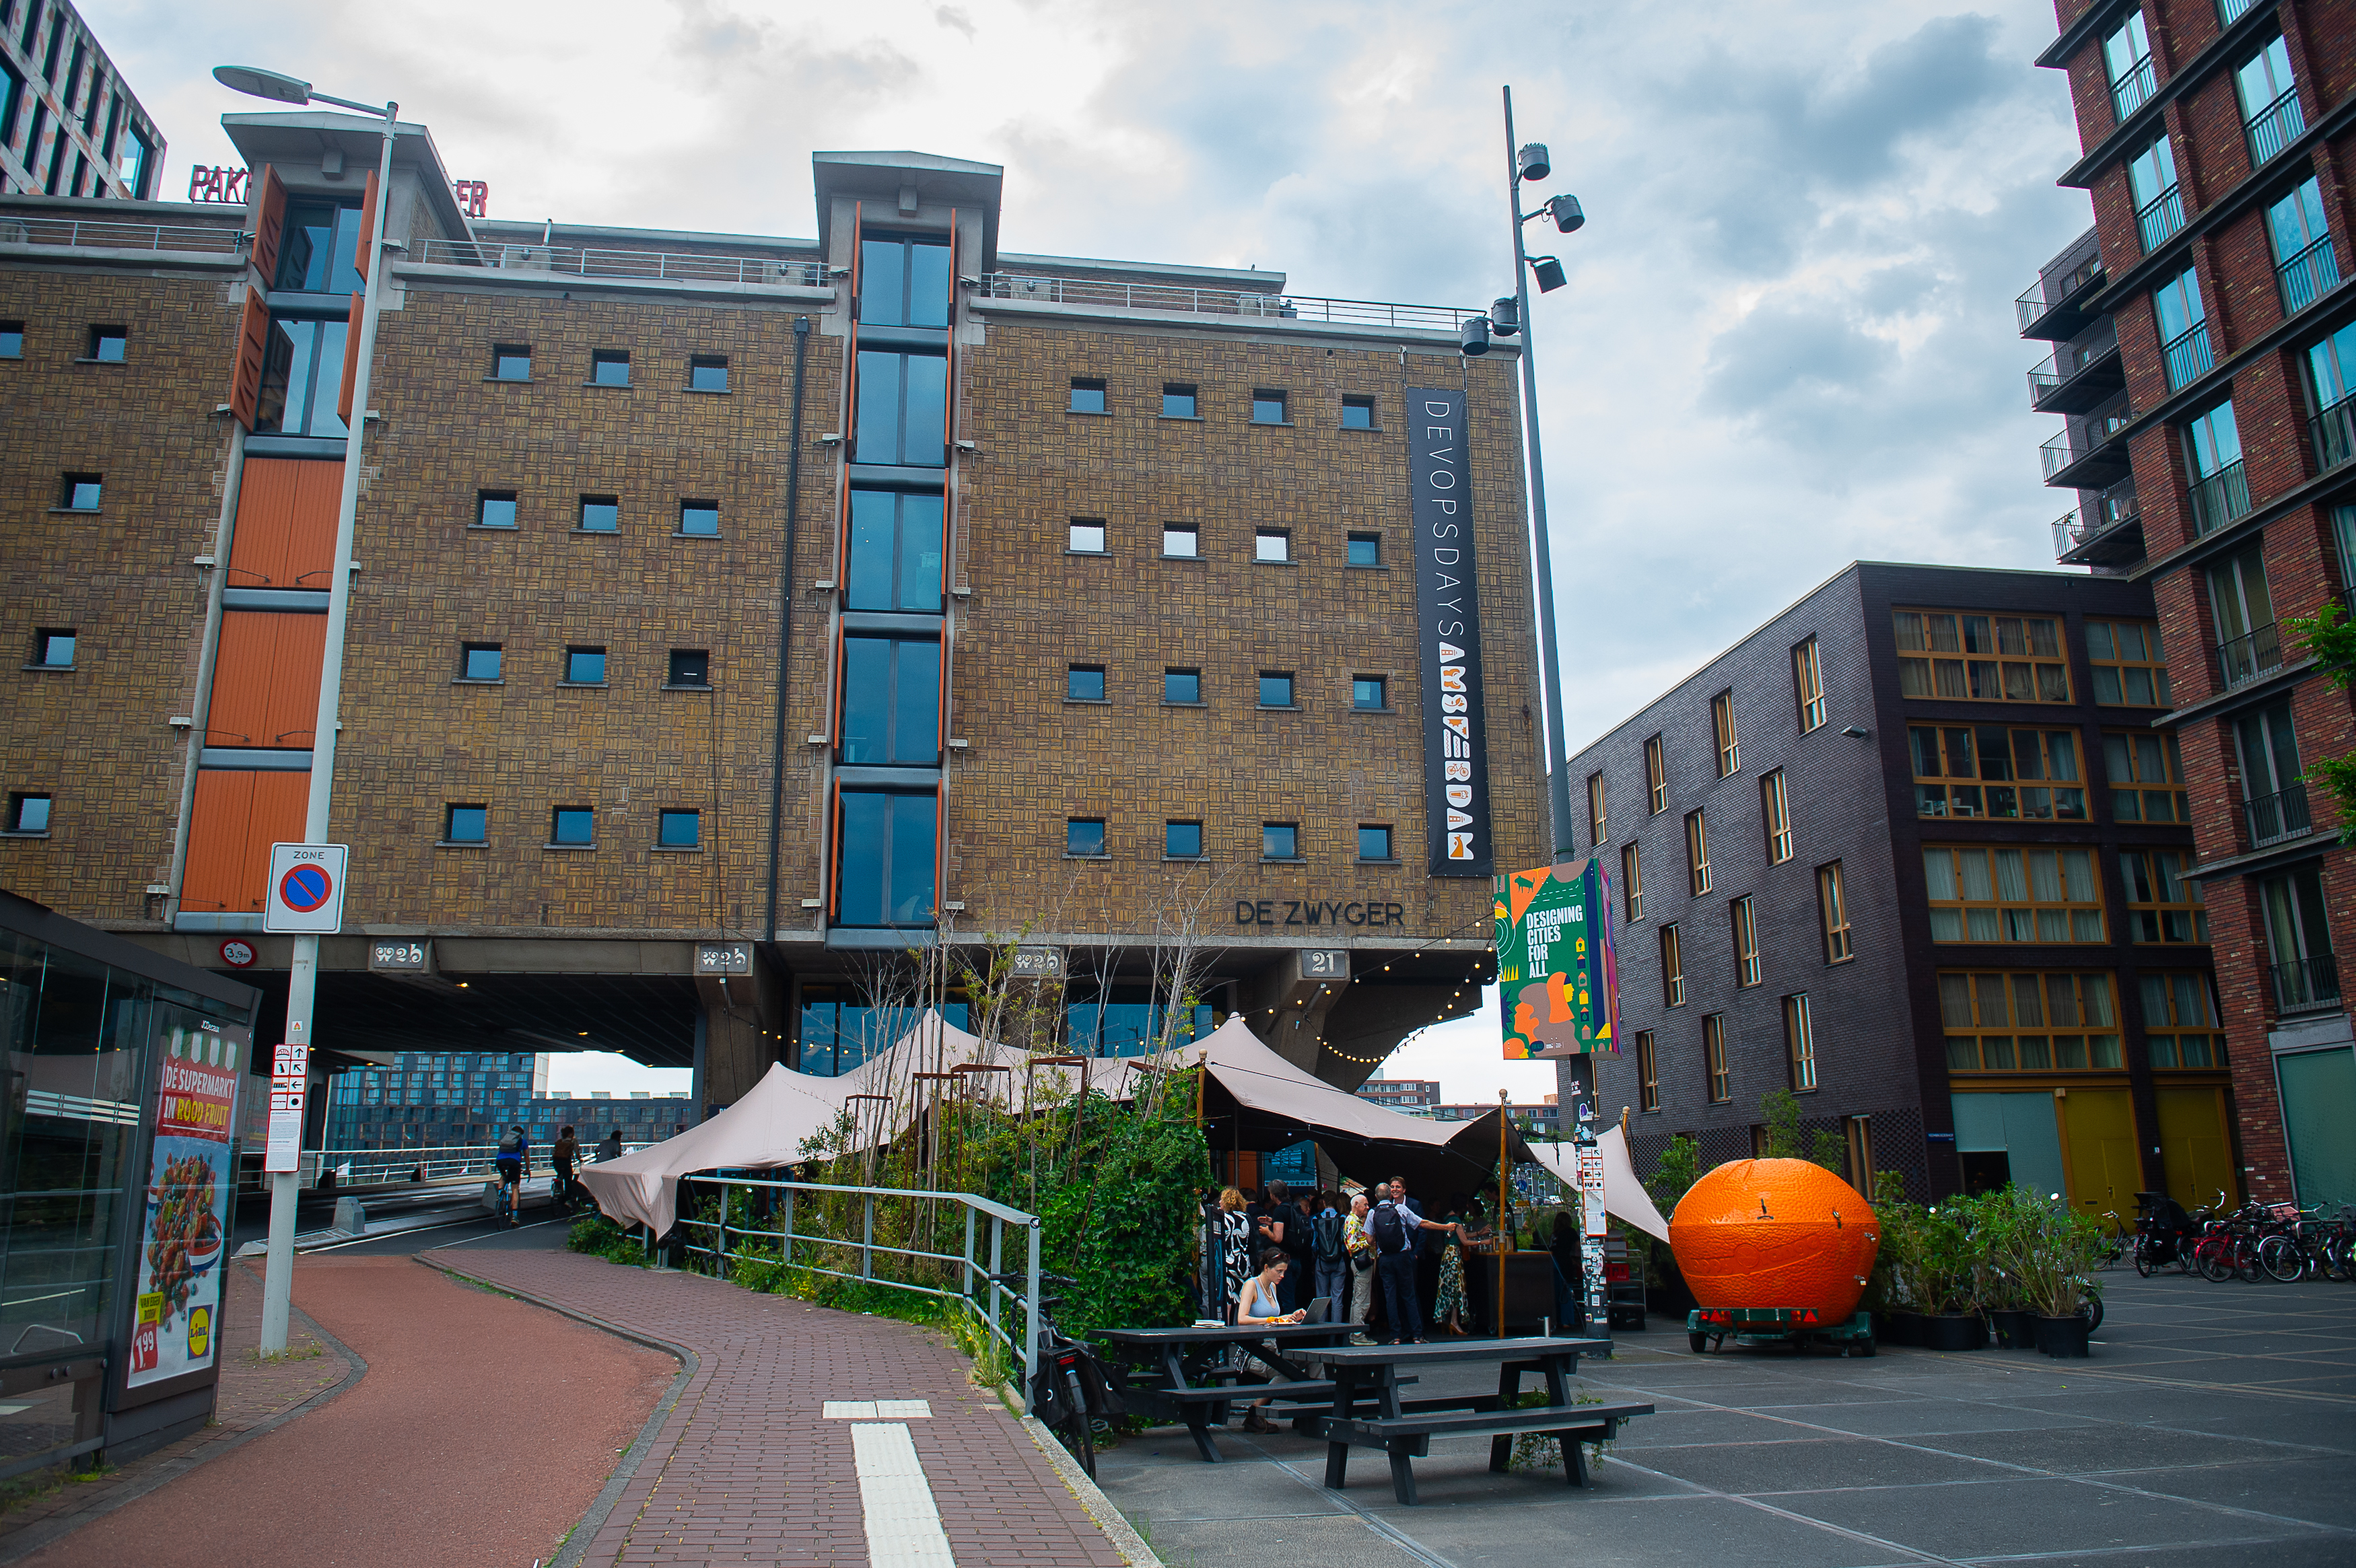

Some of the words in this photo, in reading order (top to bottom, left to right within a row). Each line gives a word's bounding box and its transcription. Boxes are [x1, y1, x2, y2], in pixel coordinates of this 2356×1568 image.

[293, 851, 325, 860] ZONE
[1236, 900, 1274, 925] DE
[1283, 901, 1404, 925] ZWYGER
[1526, 904, 1583, 929] DESIGNING
[1527, 925, 1562, 946] CITIES
[1312, 952, 1334, 973] 21
[1527, 943, 1548, 962] FOR
[1529, 960, 1548, 978] ALL
[166, 1063, 178, 1090] DÉ
[178, 1068, 235, 1099] SUPERMARKT
[164, 1096, 176, 1119] IN
[176, 1098, 204, 1122] ROOD
[204, 1103, 229, 1126] FRUIT
